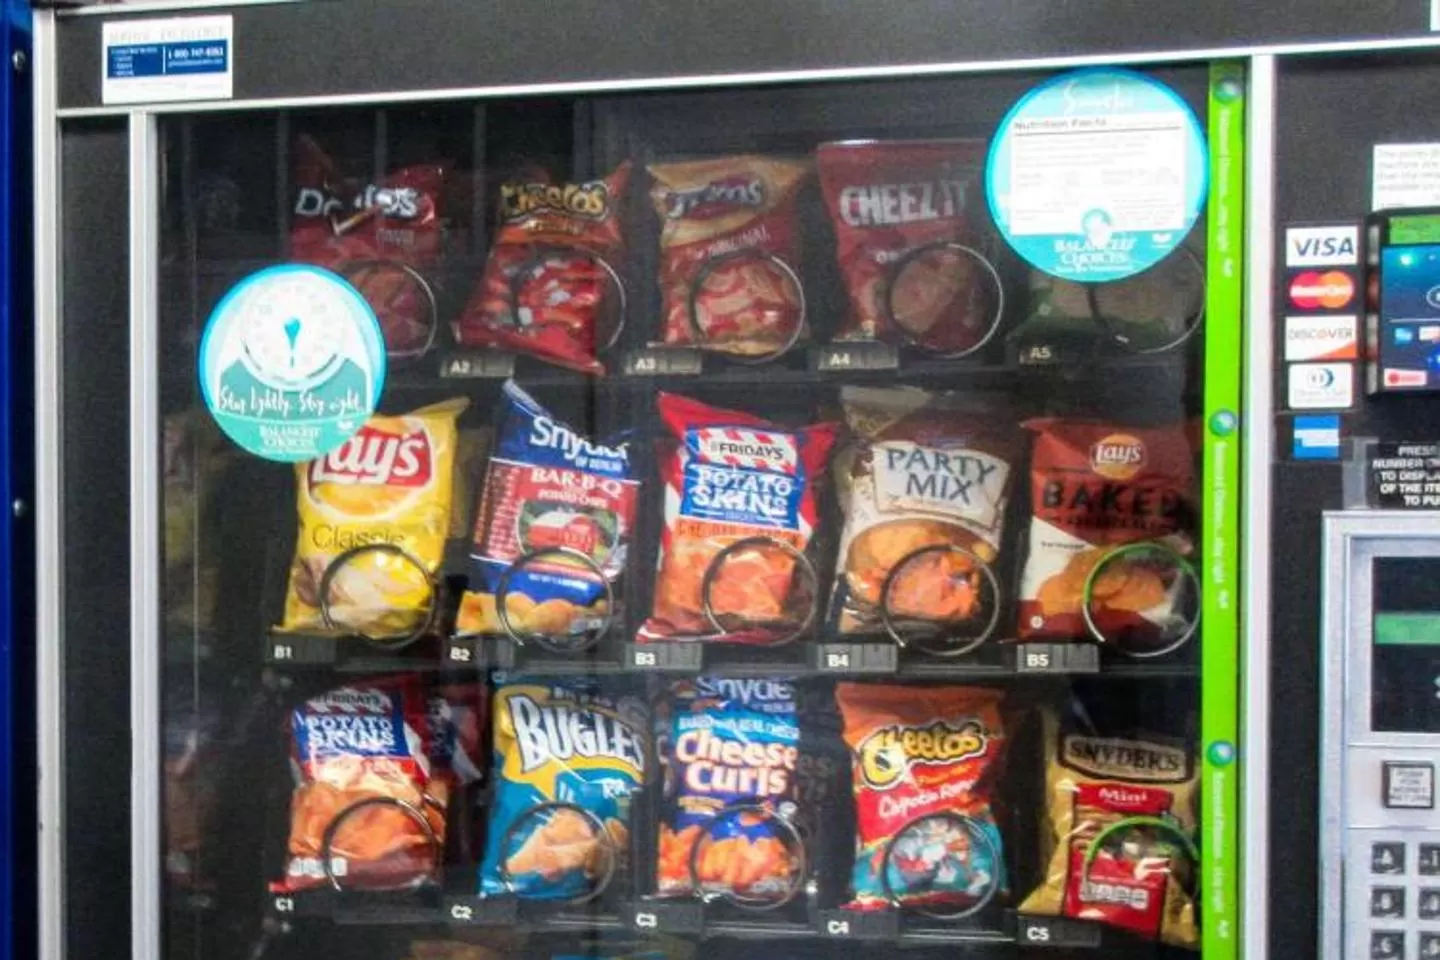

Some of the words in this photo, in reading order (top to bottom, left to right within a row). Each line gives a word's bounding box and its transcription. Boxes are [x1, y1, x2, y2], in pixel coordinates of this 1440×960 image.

[1293, 236, 1355, 257] VISA
[885, 446, 997, 484] PARTY
[697, 466, 792, 497] POTATO
[1380, 482, 1397, 495] OF
[904, 473, 975, 505] MIX
[690, 484, 789, 516] SKINS
[1403, 494, 1420, 507] TO
[274, 645, 292, 659] B1
[450, 645, 471, 661] B2
[634, 652, 656, 666] B3
[827, 652, 849, 666] B4
[1026, 654, 1049, 668] B5
[509, 696, 646, 773] BUGLES
[275, 898, 294, 911] C1
[451, 905, 472, 920] C2
[635, 914, 657, 927] C3
[1026, 926, 1050, 940] C5
